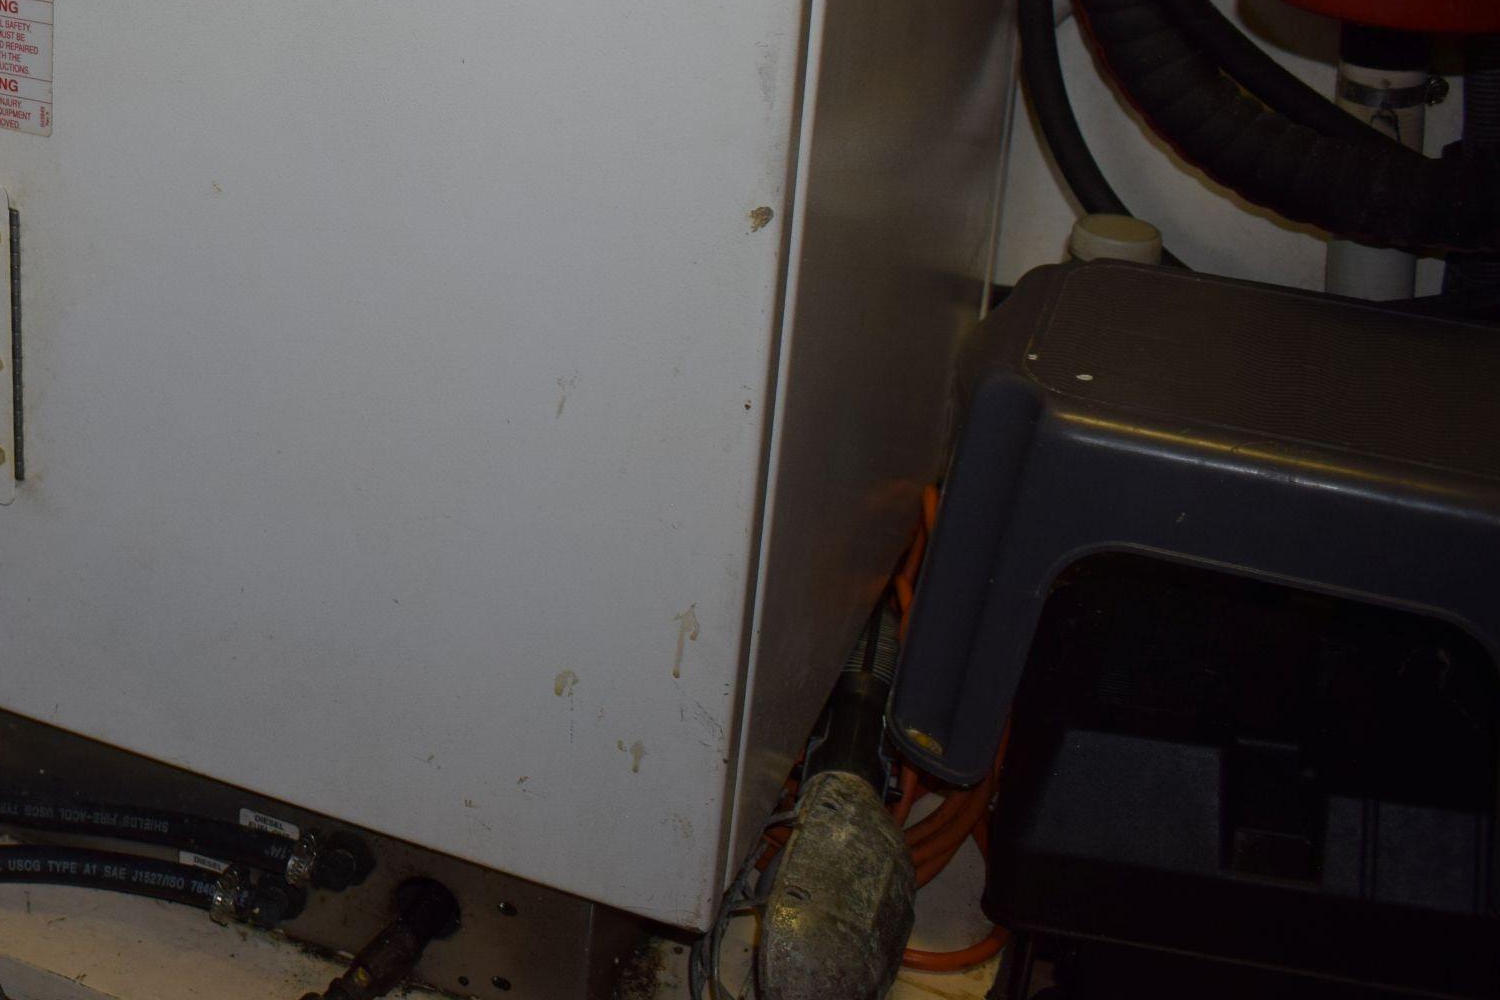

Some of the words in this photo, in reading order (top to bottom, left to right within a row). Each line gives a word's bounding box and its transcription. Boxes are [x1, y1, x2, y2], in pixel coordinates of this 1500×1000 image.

[17, 32, 25, 42] BE
[6, 42, 38, 55] REPAIRED
[9, 52, 21, 62] THE
[122, 817, 170, 834] SHIELDS
[7, 858, 41, 872] USCG
[48, 860, 79, 874] TYPE
[83, 864, 98, 877] A1
[103, 865, 127, 879] SAE
